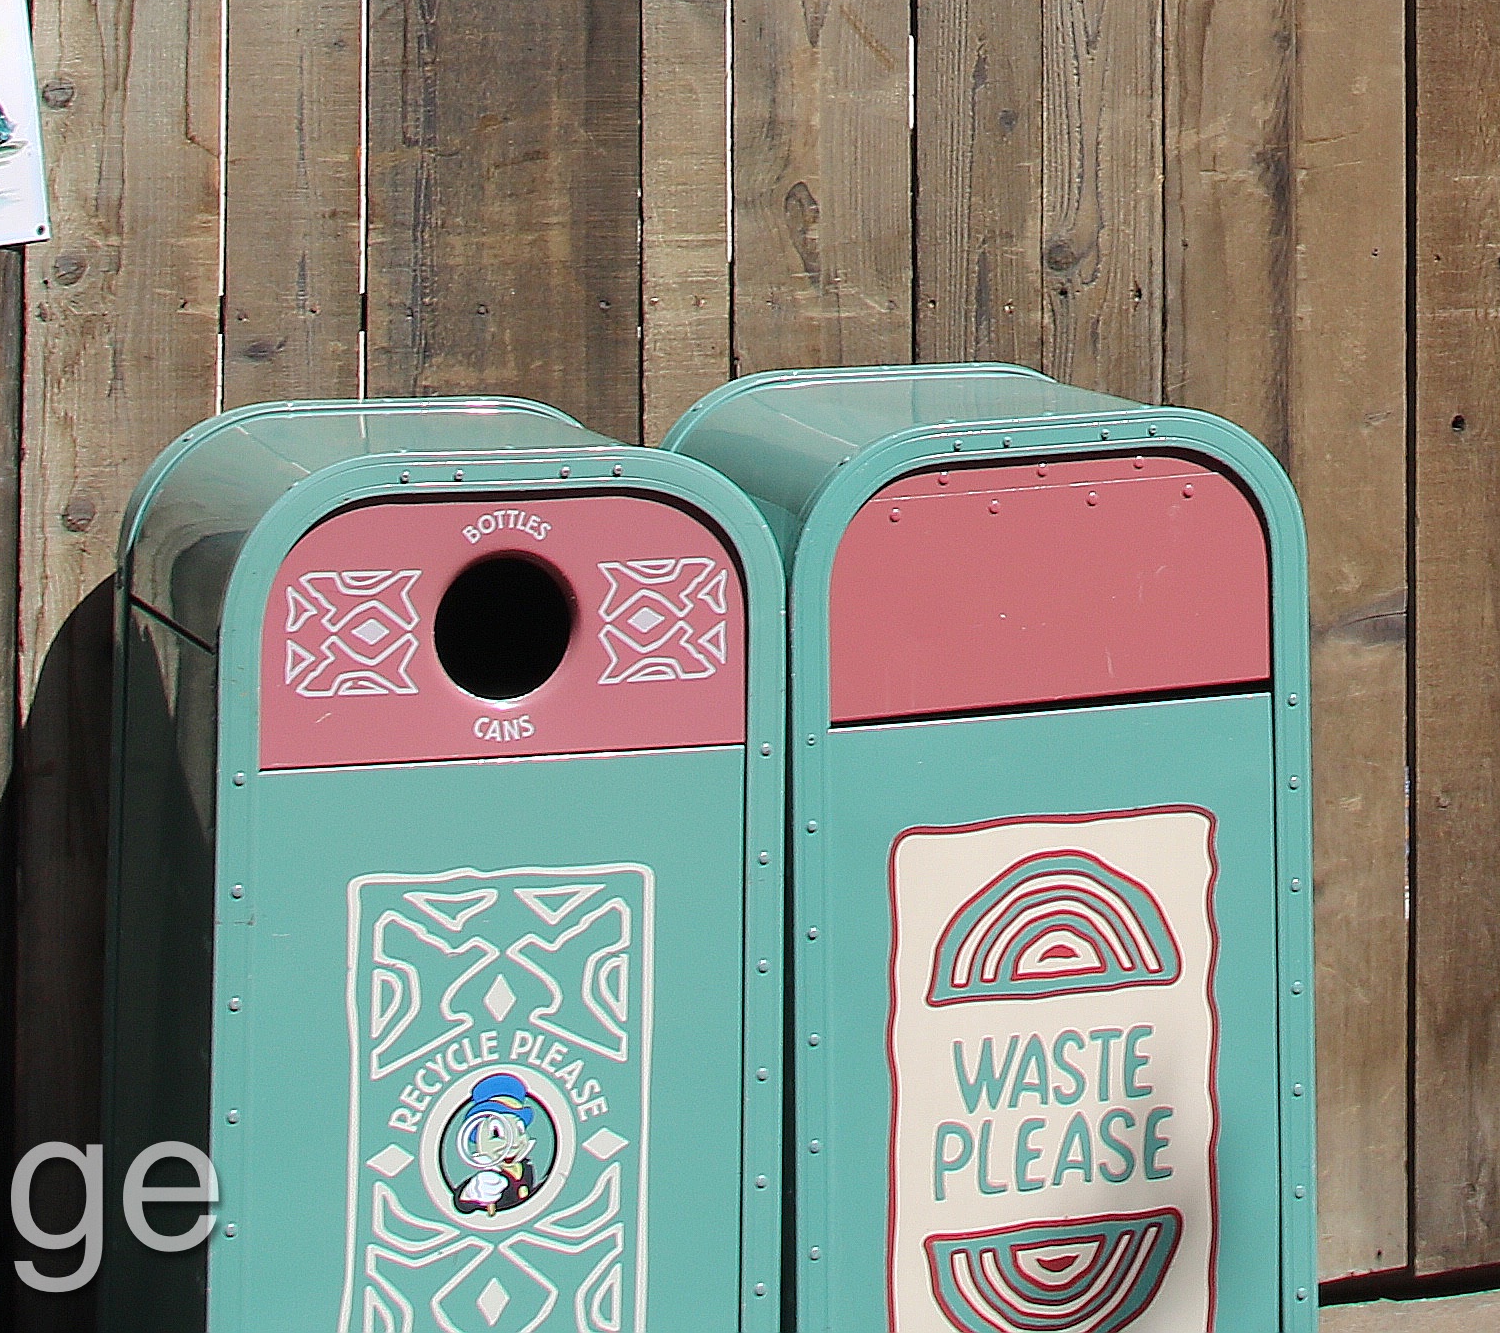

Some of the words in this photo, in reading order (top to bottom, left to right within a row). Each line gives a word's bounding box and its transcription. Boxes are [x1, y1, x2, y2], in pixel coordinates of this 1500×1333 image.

[462, 509, 552, 544] BOTTLES
[473, 715, 536, 742] CANS
[388, 1030, 500, 1133] RECYCLE
[509, 1030, 609, 1122] PLEASE
[952, 1023, 1155, 1115] WASTE
[933, 1105, 1175, 1202] PLEASE
